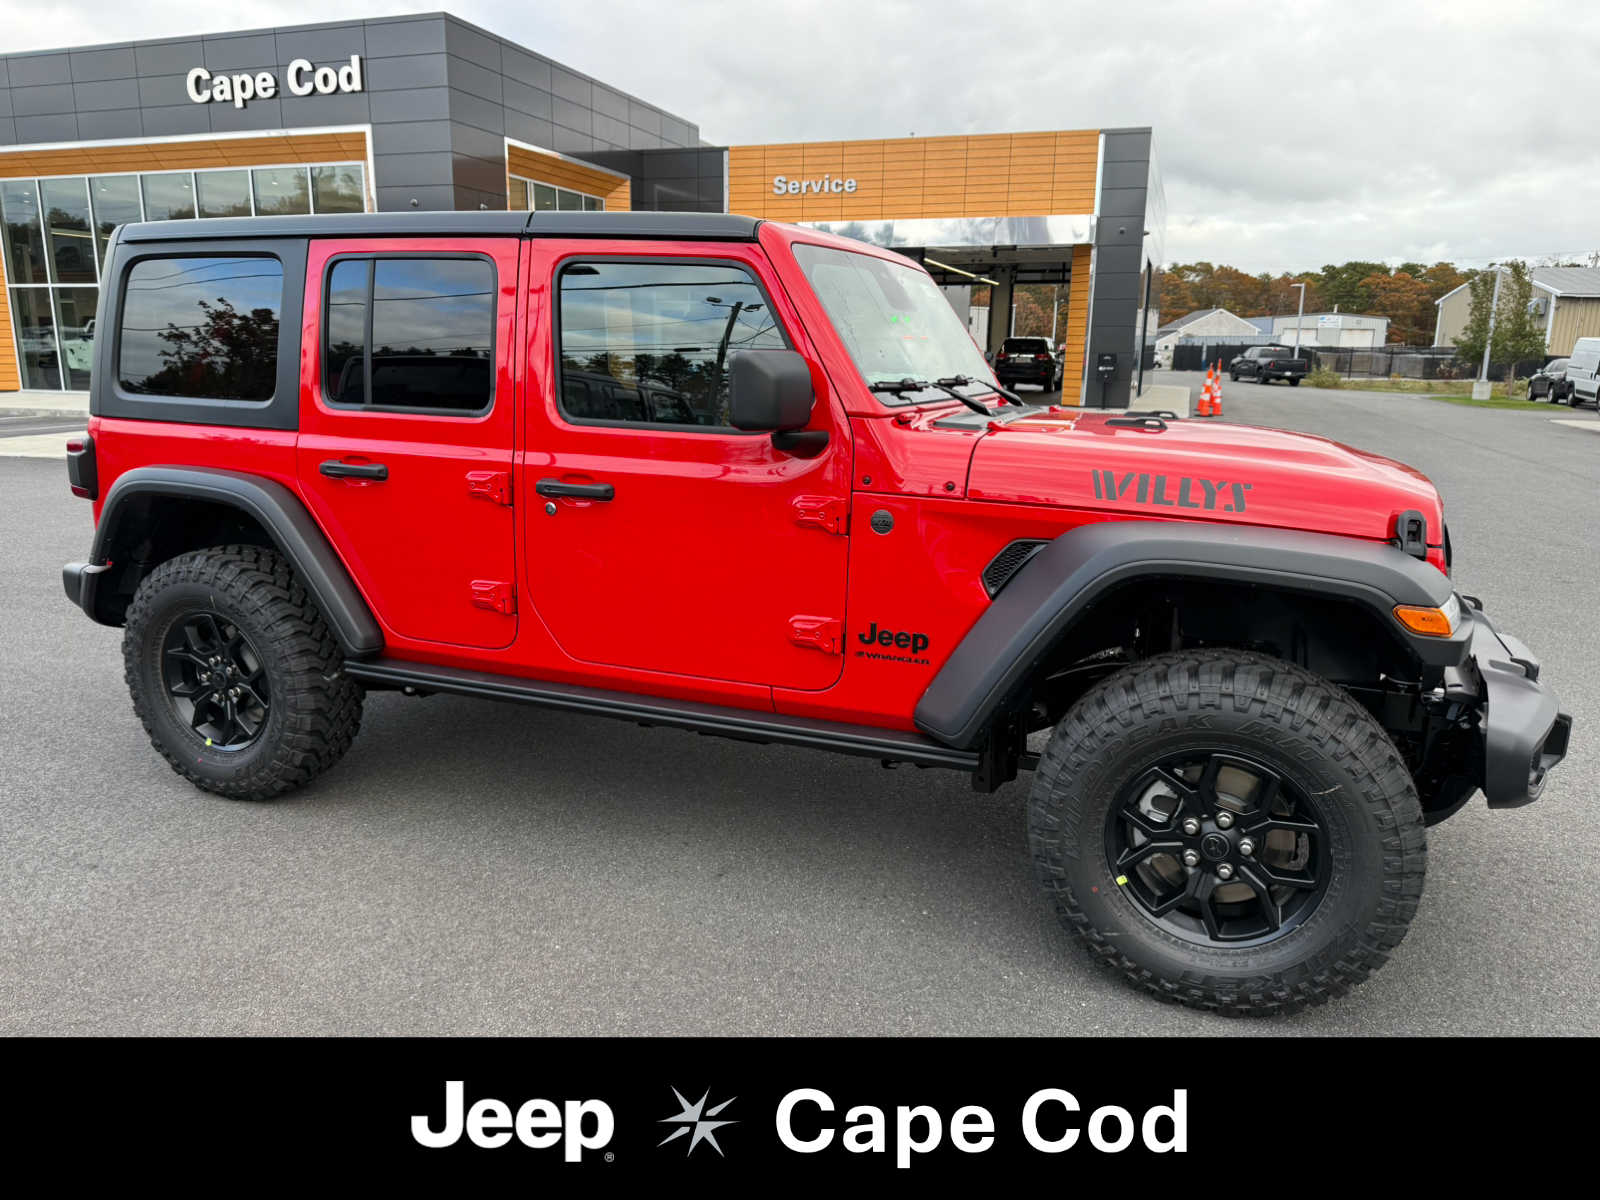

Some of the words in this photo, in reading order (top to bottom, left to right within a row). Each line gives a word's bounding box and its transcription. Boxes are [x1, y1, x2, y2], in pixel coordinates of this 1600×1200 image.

[186, 67, 276, 109] Cape
[287, 54, 363, 96] Cod
[773, 174, 857, 195] Service
[1092, 469, 1253, 513] WILLYS
[858, 623, 929, 654] Jeep
